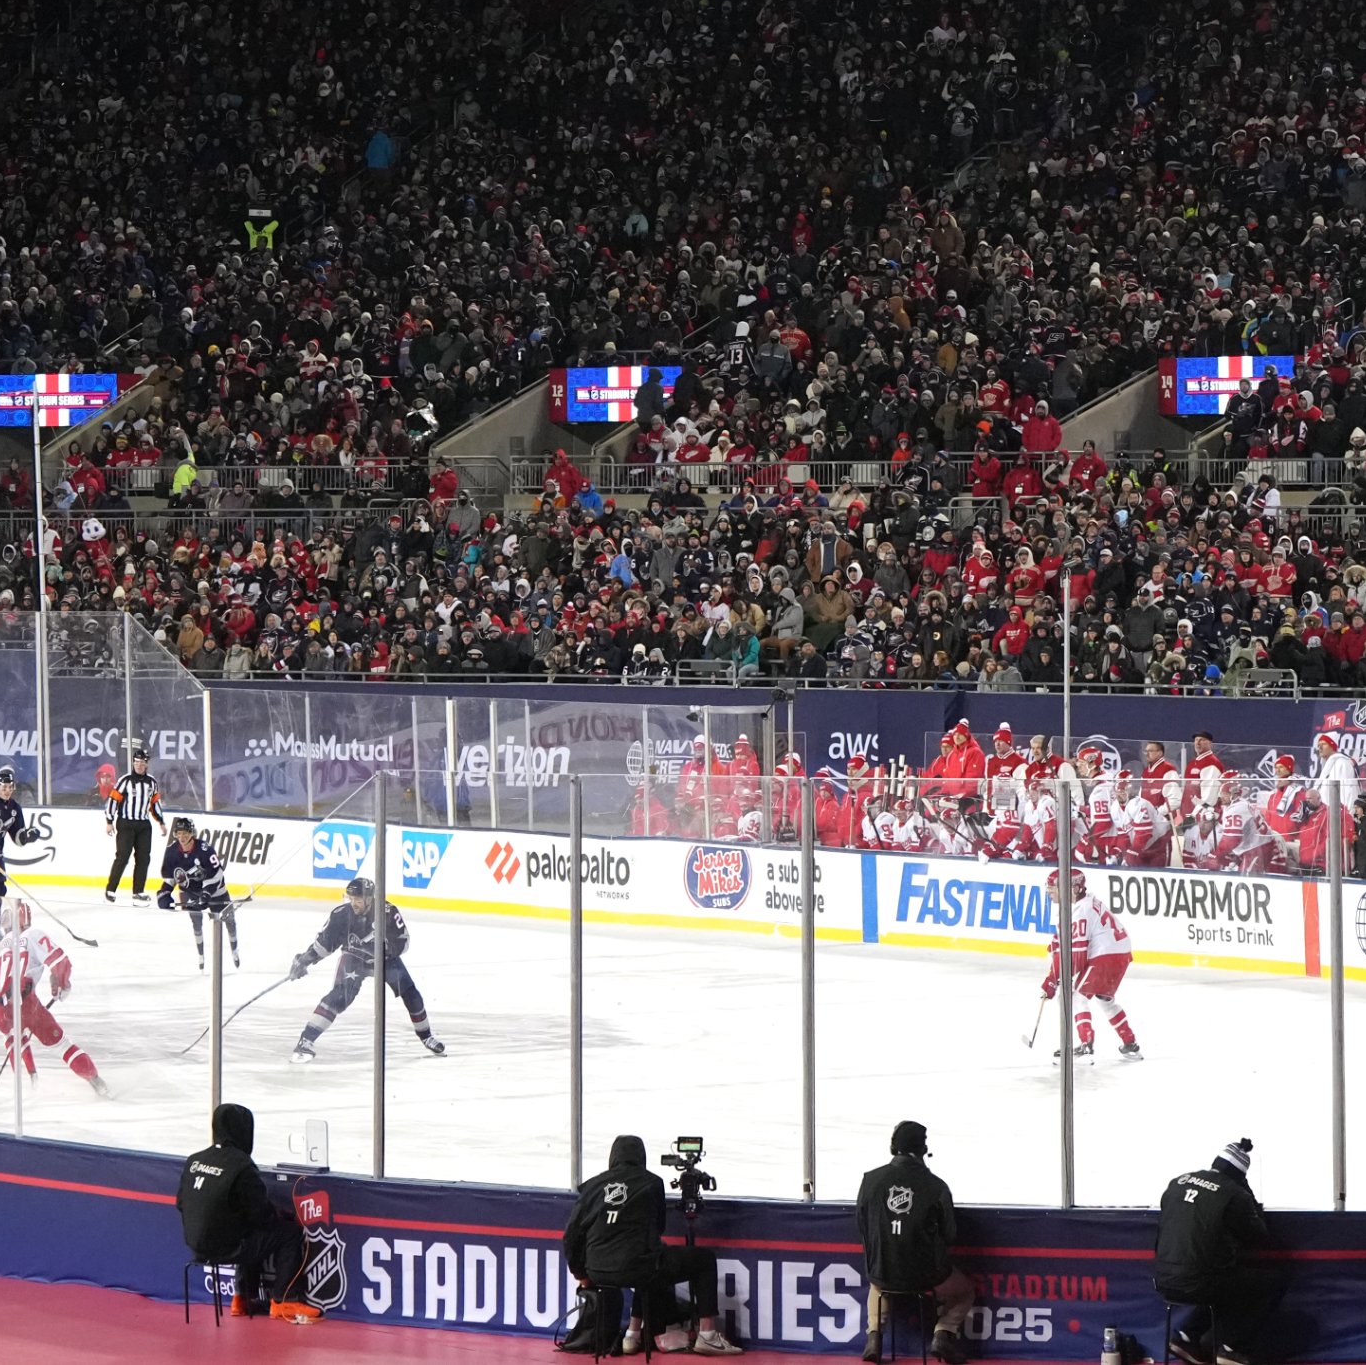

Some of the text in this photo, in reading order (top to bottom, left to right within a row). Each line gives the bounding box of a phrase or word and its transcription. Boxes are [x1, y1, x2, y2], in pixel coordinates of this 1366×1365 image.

[730, 349, 743, 364] 13
[1161, 375, 1173, 388] 14
[552, 385, 563, 397] 12
[1164, 391, 1170, 399] A
[25, 395, 57, 406] STDIUM
[555, 398, 561, 406] A
[1094, 800, 1109, 813] 85
[313, 831, 367, 871] SAP
[403, 838, 439, 880] SAP
[693, 847, 742, 873] Jersey
[767, 865, 775, 882] a
[712, 897, 732, 909] SUBS
[1108, 874, 1273, 925] BODYARMOR
[1187, 923, 1275, 947] Sports Drink
[198, 1164, 224, 1177] IMAGES
[1186, 1175, 1220, 1193] IMAGES
[1183, 1188, 1198, 1203] 12
[300, 1198, 323, 1222] The
[307, 1252, 337, 1286] NHL
[716, 1258, 862, 1344] RIES
[968, 1306, 1053, 1343] 025
